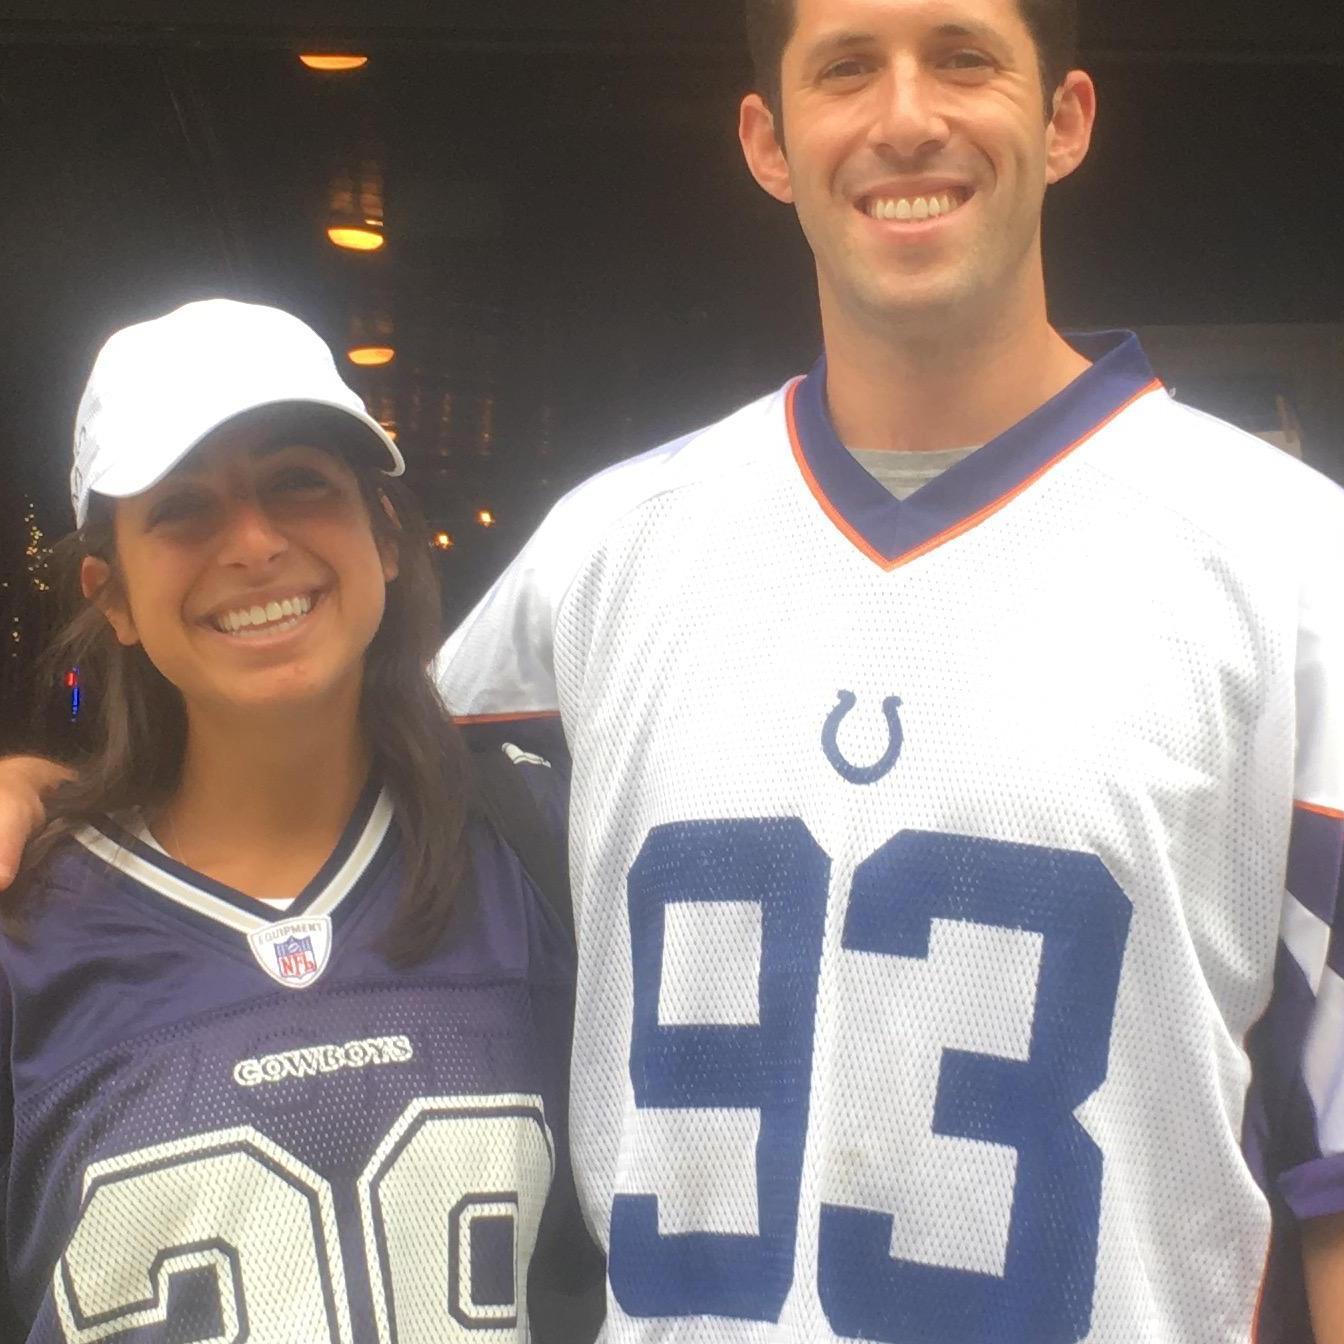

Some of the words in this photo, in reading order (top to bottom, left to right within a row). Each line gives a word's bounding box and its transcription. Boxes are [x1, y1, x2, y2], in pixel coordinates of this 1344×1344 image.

[257, 922, 323, 945] EQUIPMENT
[281, 951, 317, 978] NFL
[233, 1034, 414, 1087] COWBOYS
